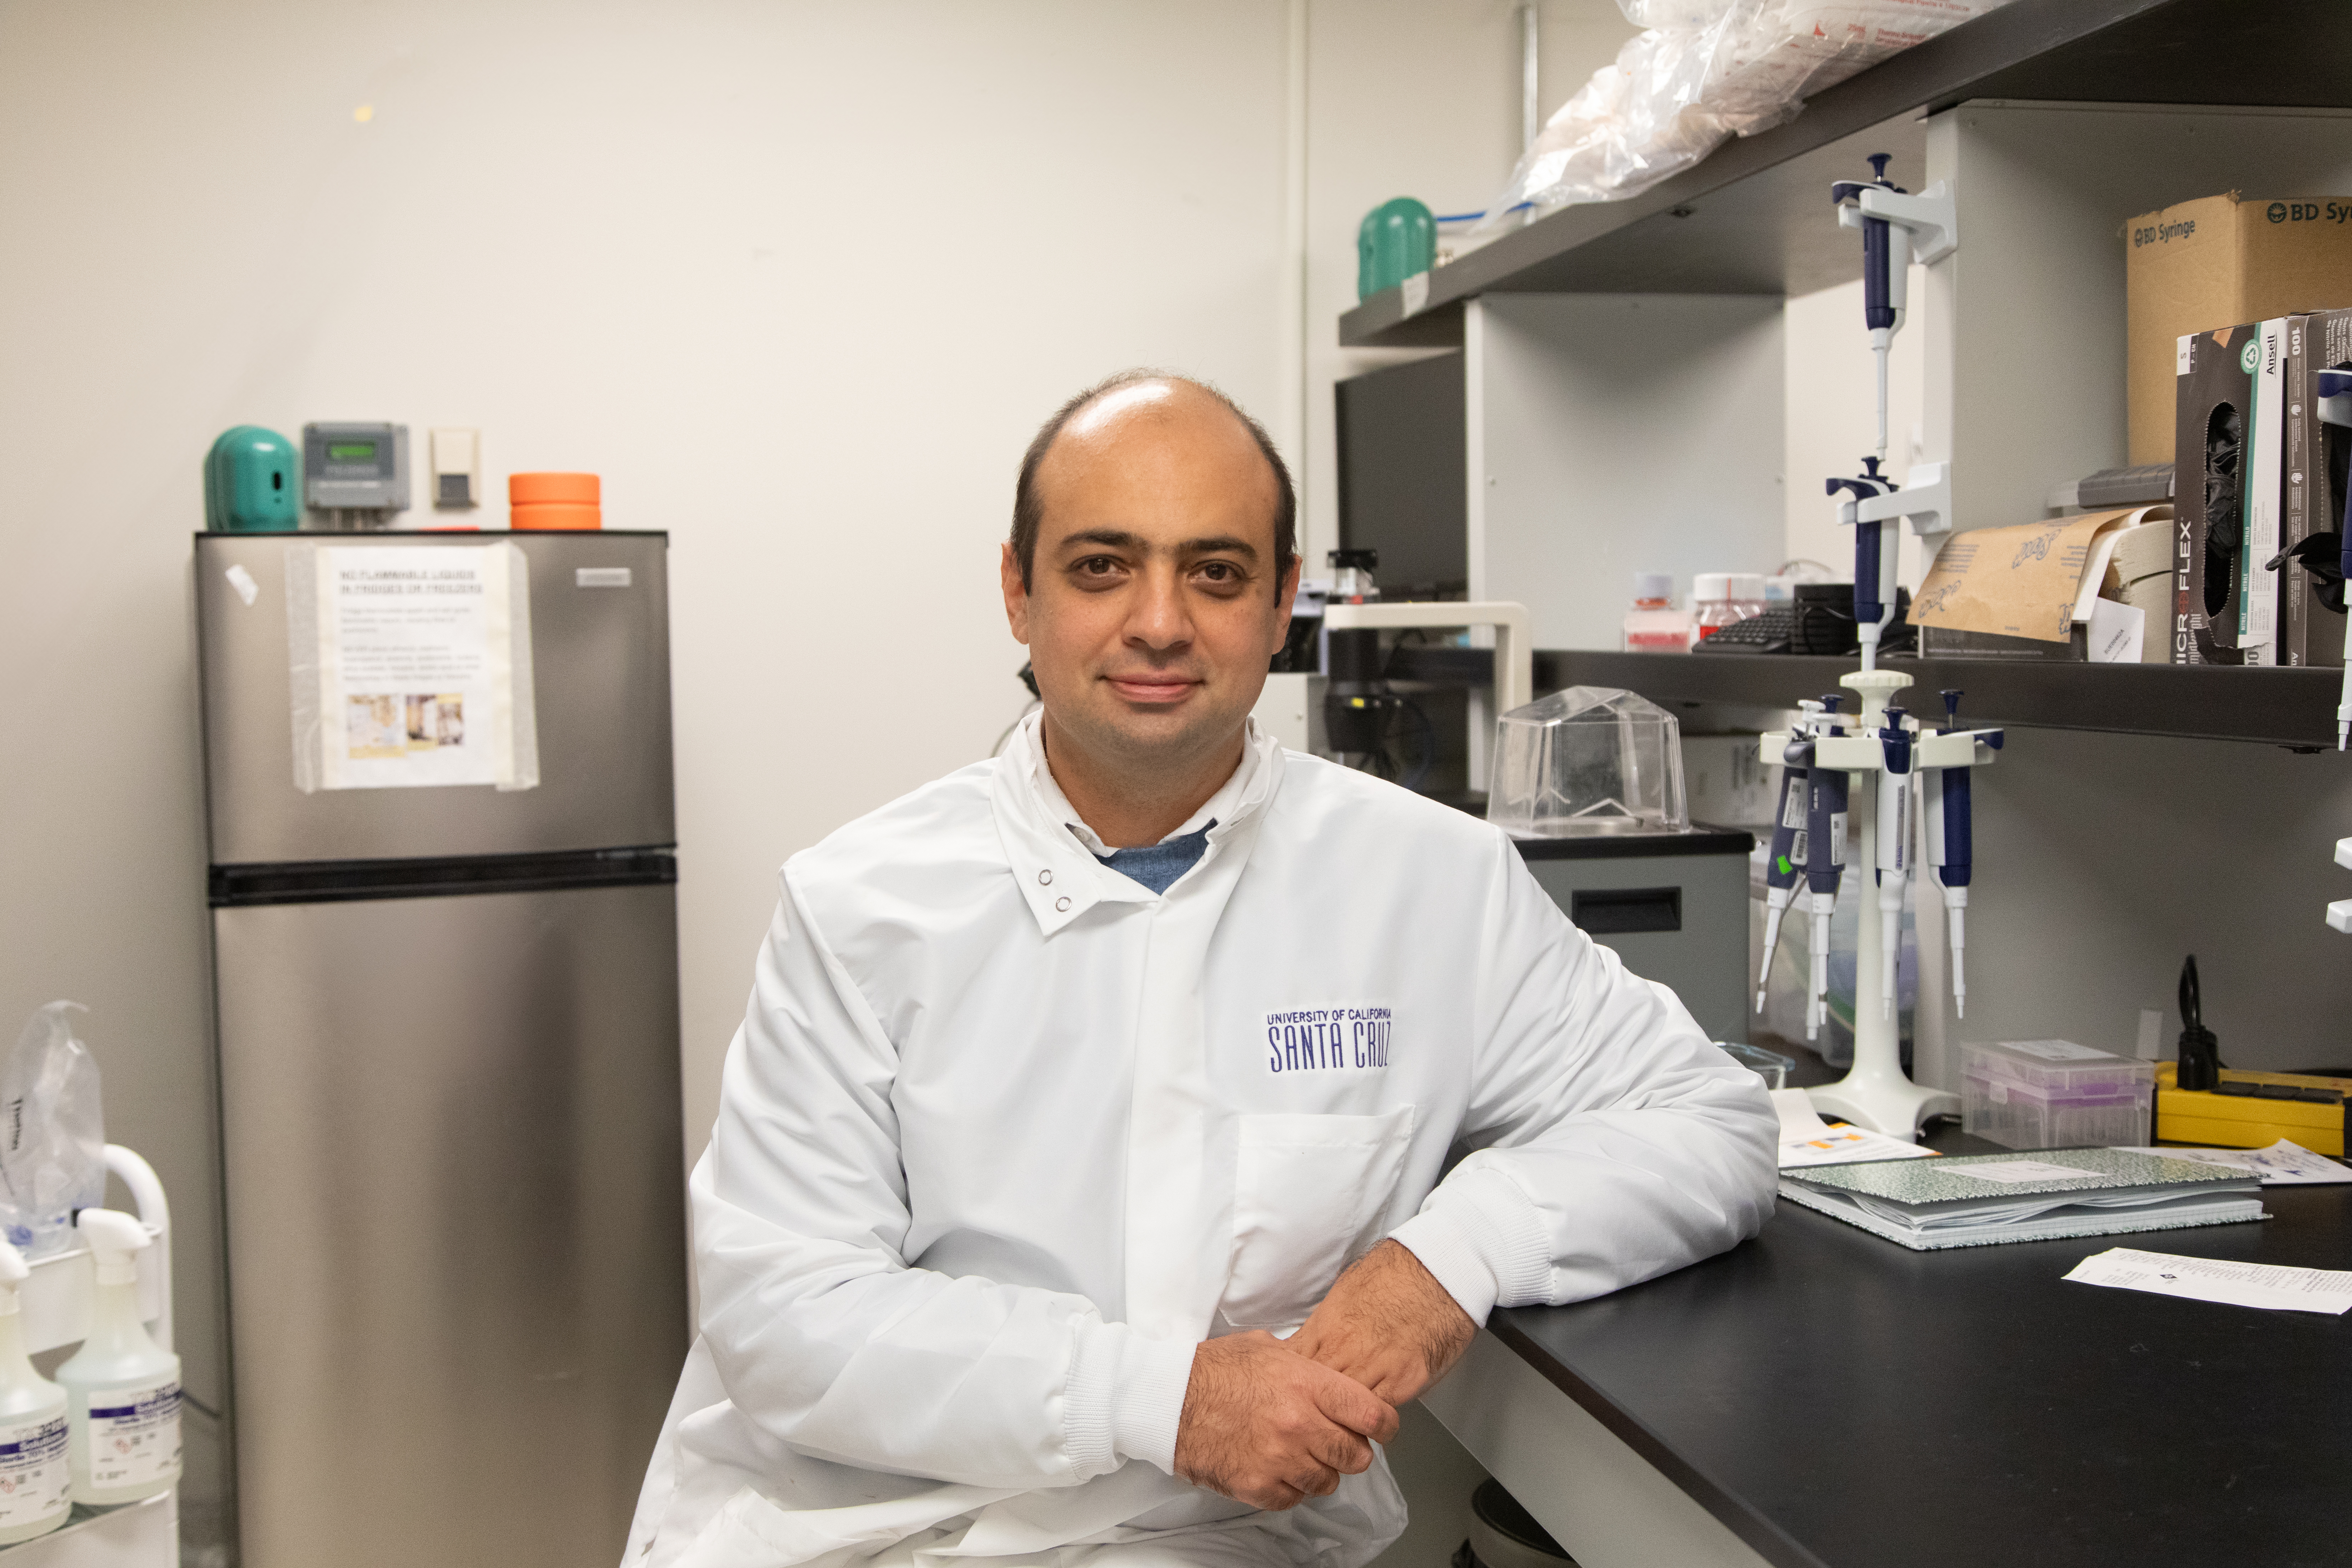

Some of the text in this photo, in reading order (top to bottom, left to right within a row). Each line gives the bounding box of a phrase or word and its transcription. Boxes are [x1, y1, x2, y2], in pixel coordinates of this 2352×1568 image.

[2291, 203, 2319, 221] BD
[2144, 219, 2196, 244] BD Syringe
[2292, 327, 2301, 355] 100
[2266, 334, 2275, 375] Ansell
[1267, 1008, 1391, 1025] UNIVERSITY OF CALIFORNIA
[1268, 1021, 1391, 1072] SANTA CRUZ
